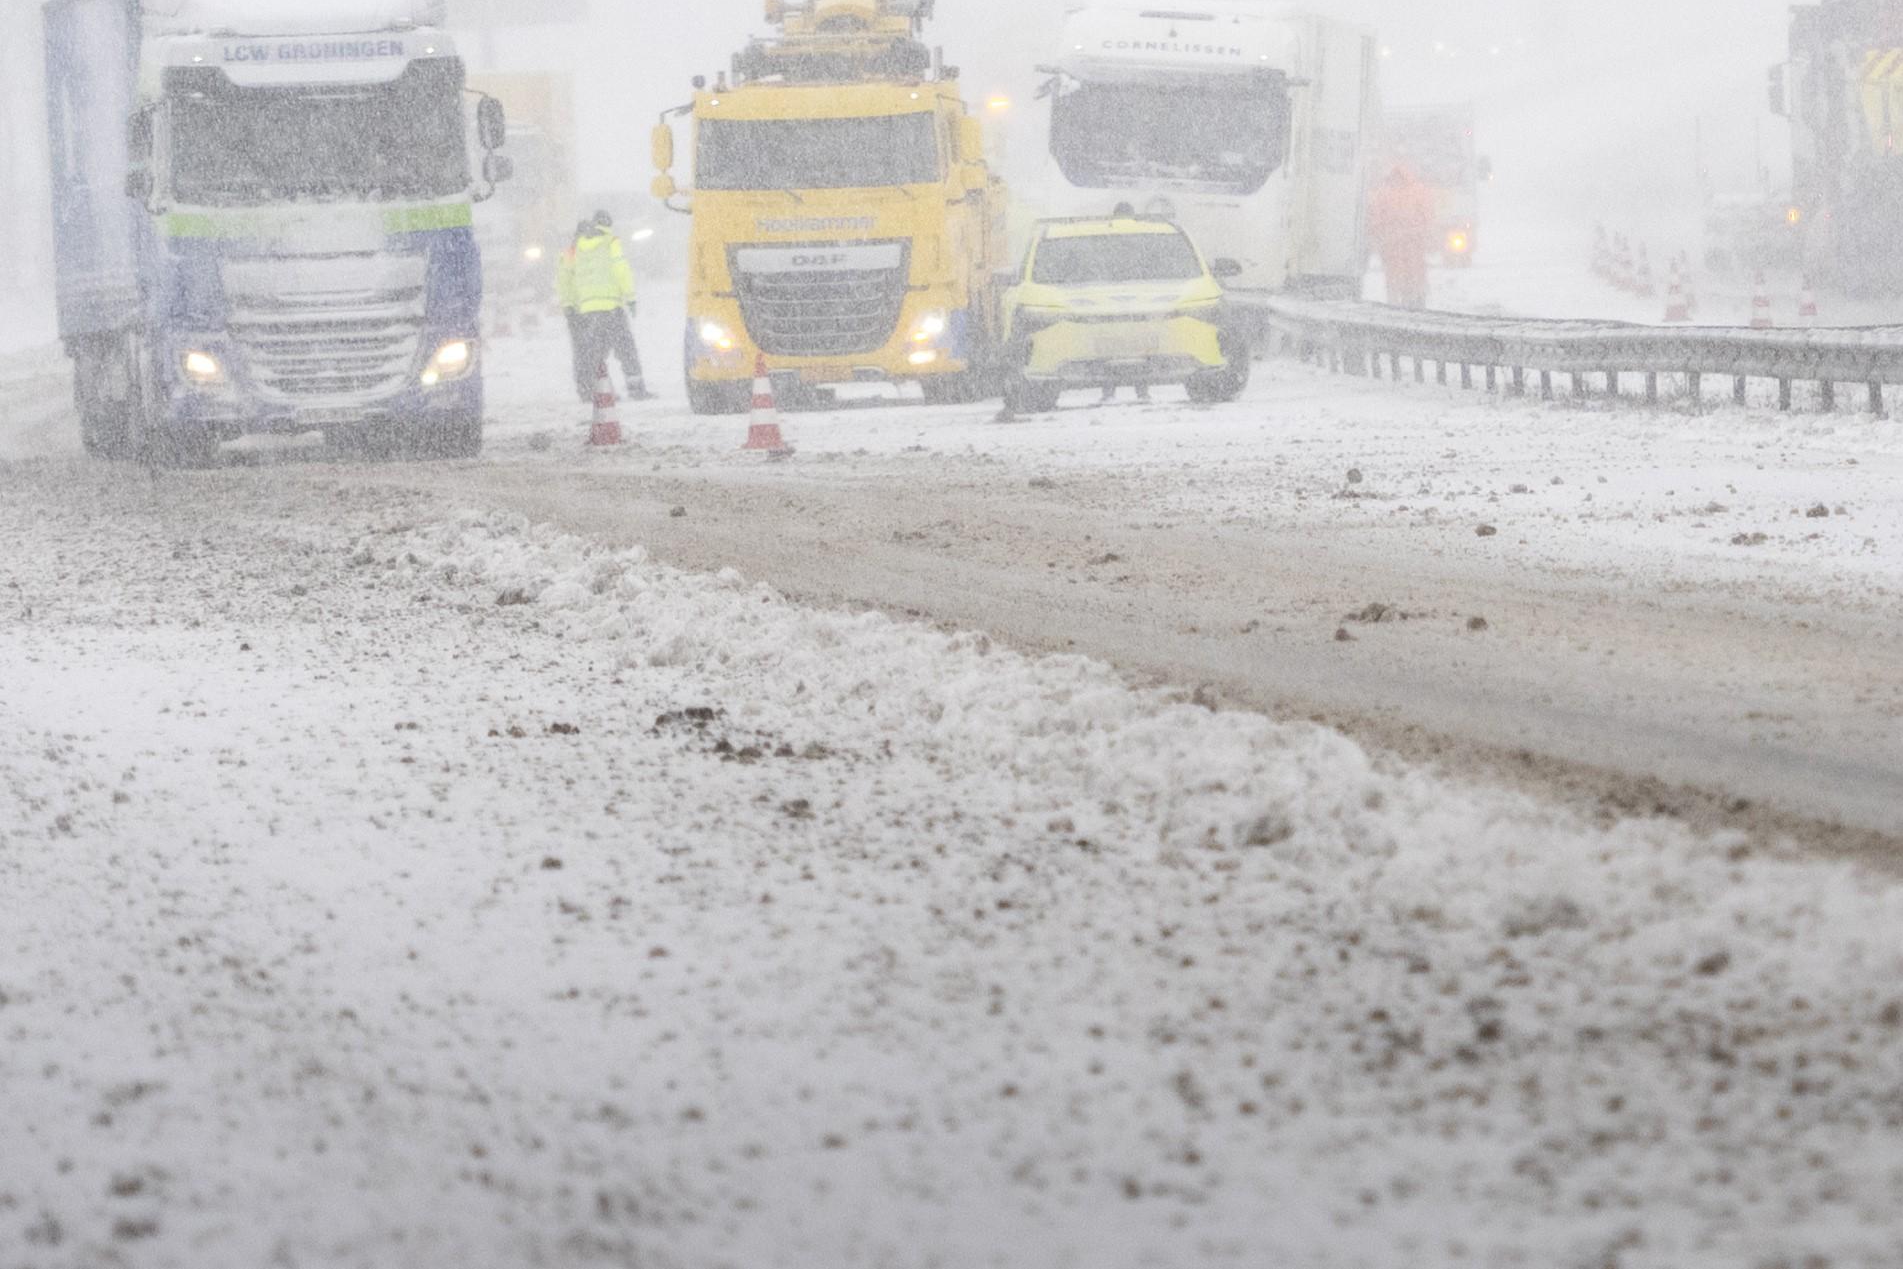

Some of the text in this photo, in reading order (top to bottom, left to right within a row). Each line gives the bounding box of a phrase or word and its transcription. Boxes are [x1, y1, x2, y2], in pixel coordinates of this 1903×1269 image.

[223, 44, 269, 62] LCW
[1101, 40, 1241, 56] CORNELISSEN
[792, 253, 847, 266] DAF
